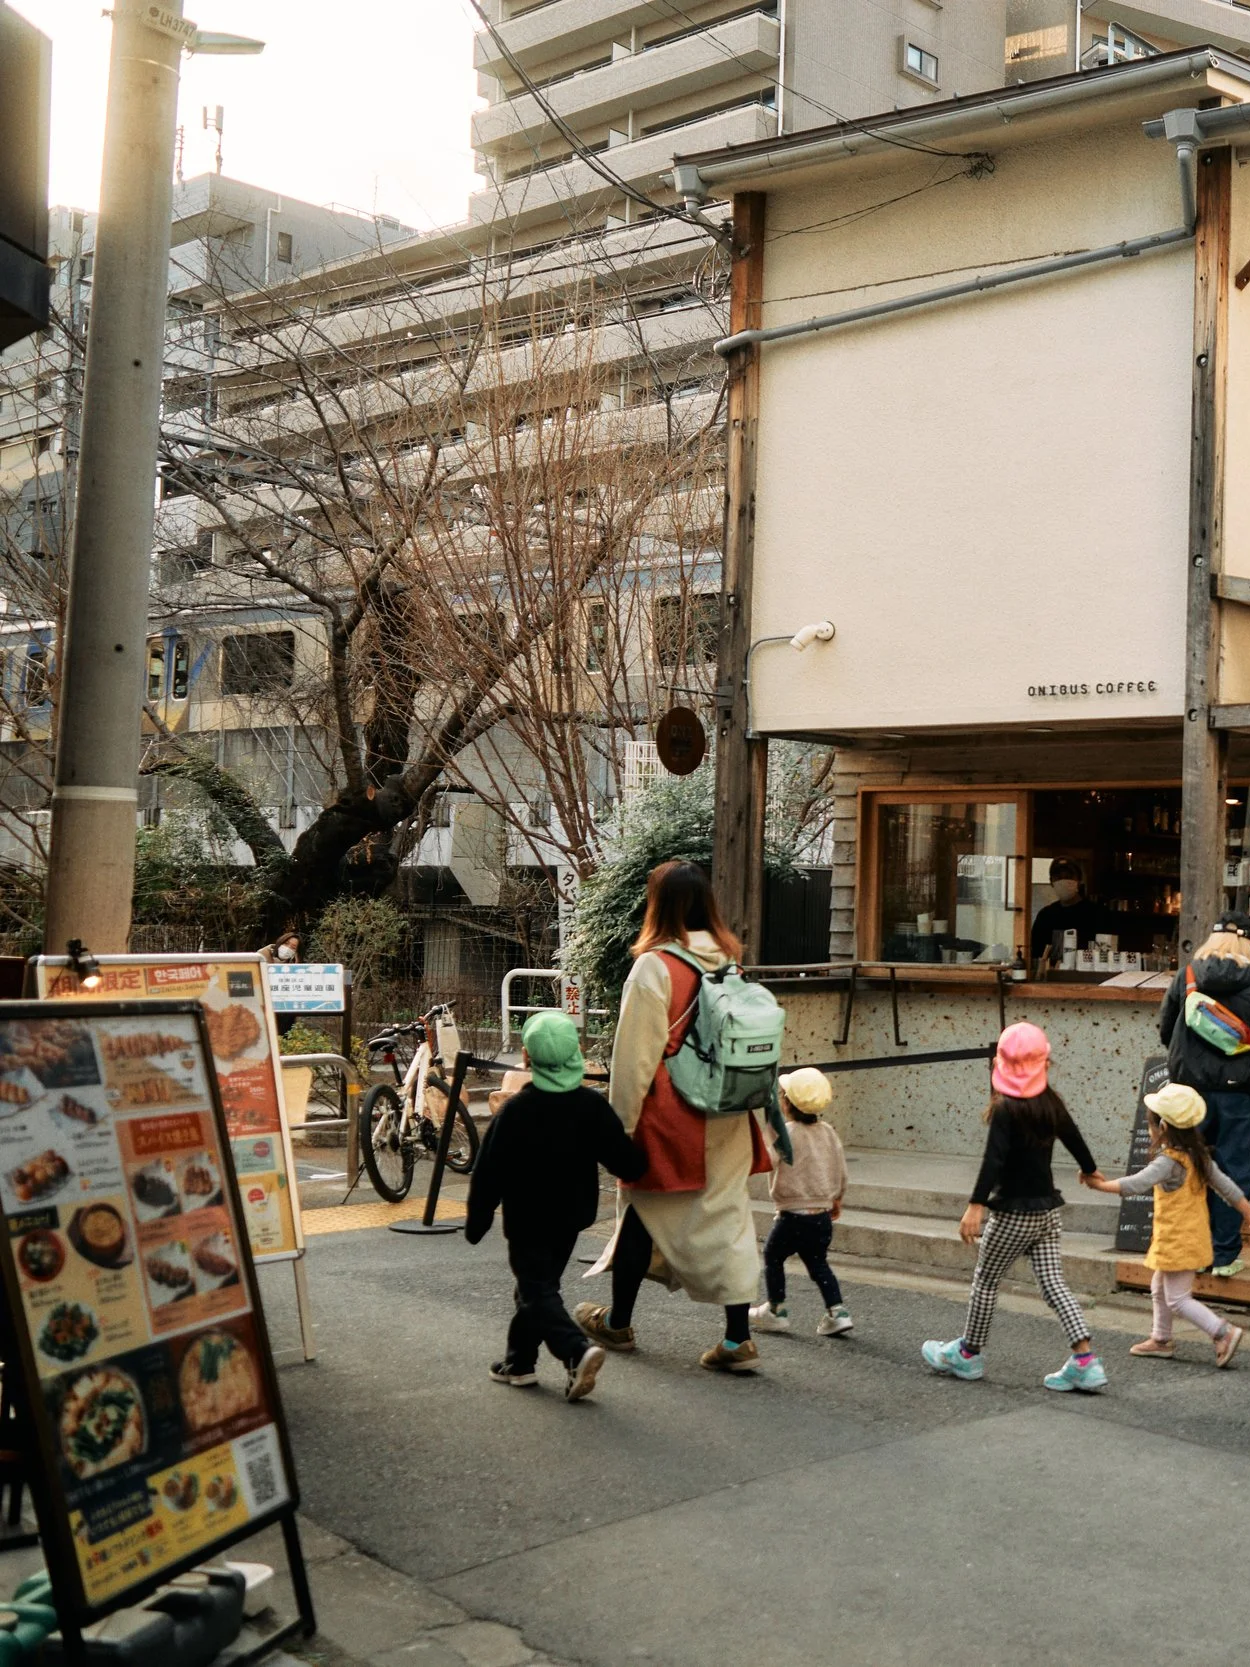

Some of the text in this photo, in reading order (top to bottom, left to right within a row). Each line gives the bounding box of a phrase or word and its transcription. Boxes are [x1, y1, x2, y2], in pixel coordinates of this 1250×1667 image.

[1027, 680, 1157, 697] ONIBUS COFFEE
[1148, 1067, 1170, 1084] ONIB
